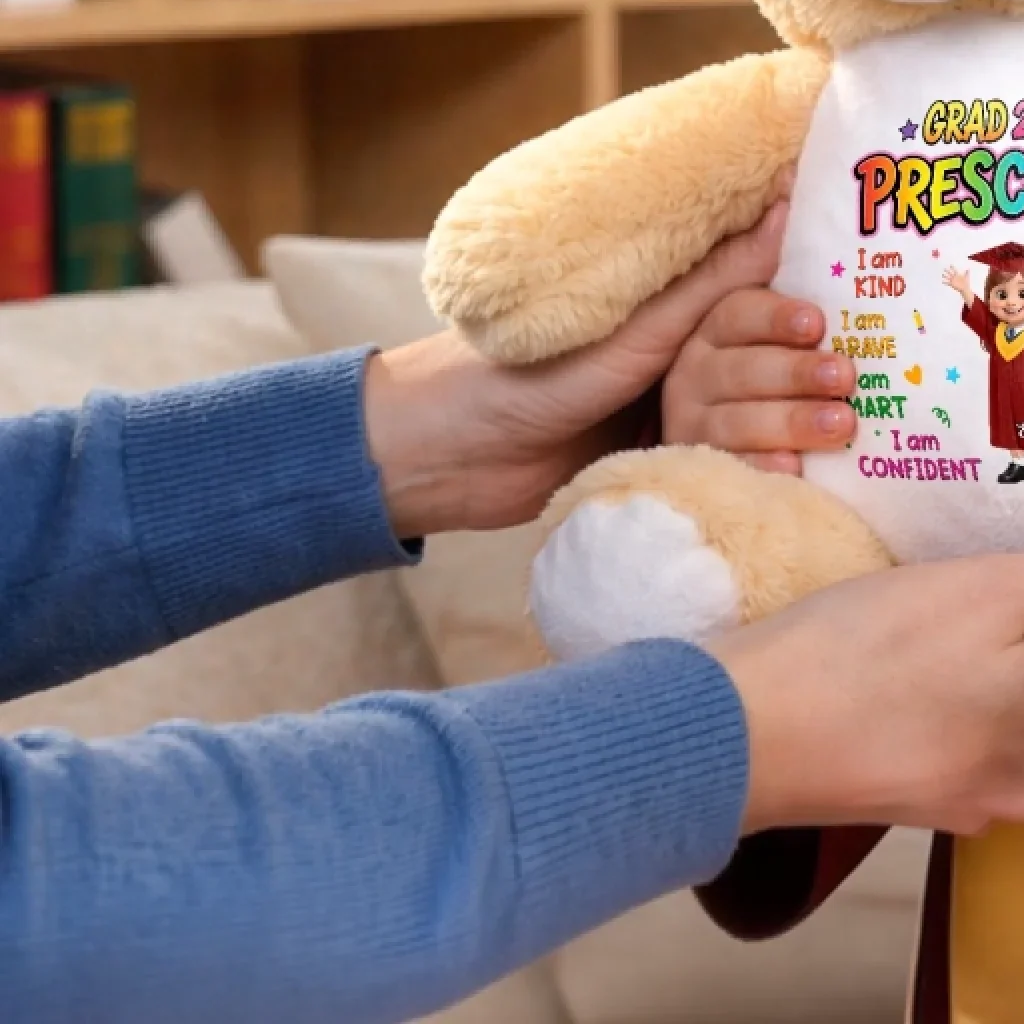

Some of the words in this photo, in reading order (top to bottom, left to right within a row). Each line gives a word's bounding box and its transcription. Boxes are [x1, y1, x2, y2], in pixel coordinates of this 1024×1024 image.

[922, 99, 1009, 145] GRAD
[857, 248, 867, 270] I
[871, 251, 902, 268] am
[854, 274, 906, 298] KIND
[840, 309, 850, 332] I
[854, 313, 886, 330] am
[857, 373, 890, 390] am
[834, 395, 907, 419] MART
[890, 429, 902, 451] I
[906, 433, 940, 452] am
[858, 454, 982, 482] CONFIDENT
